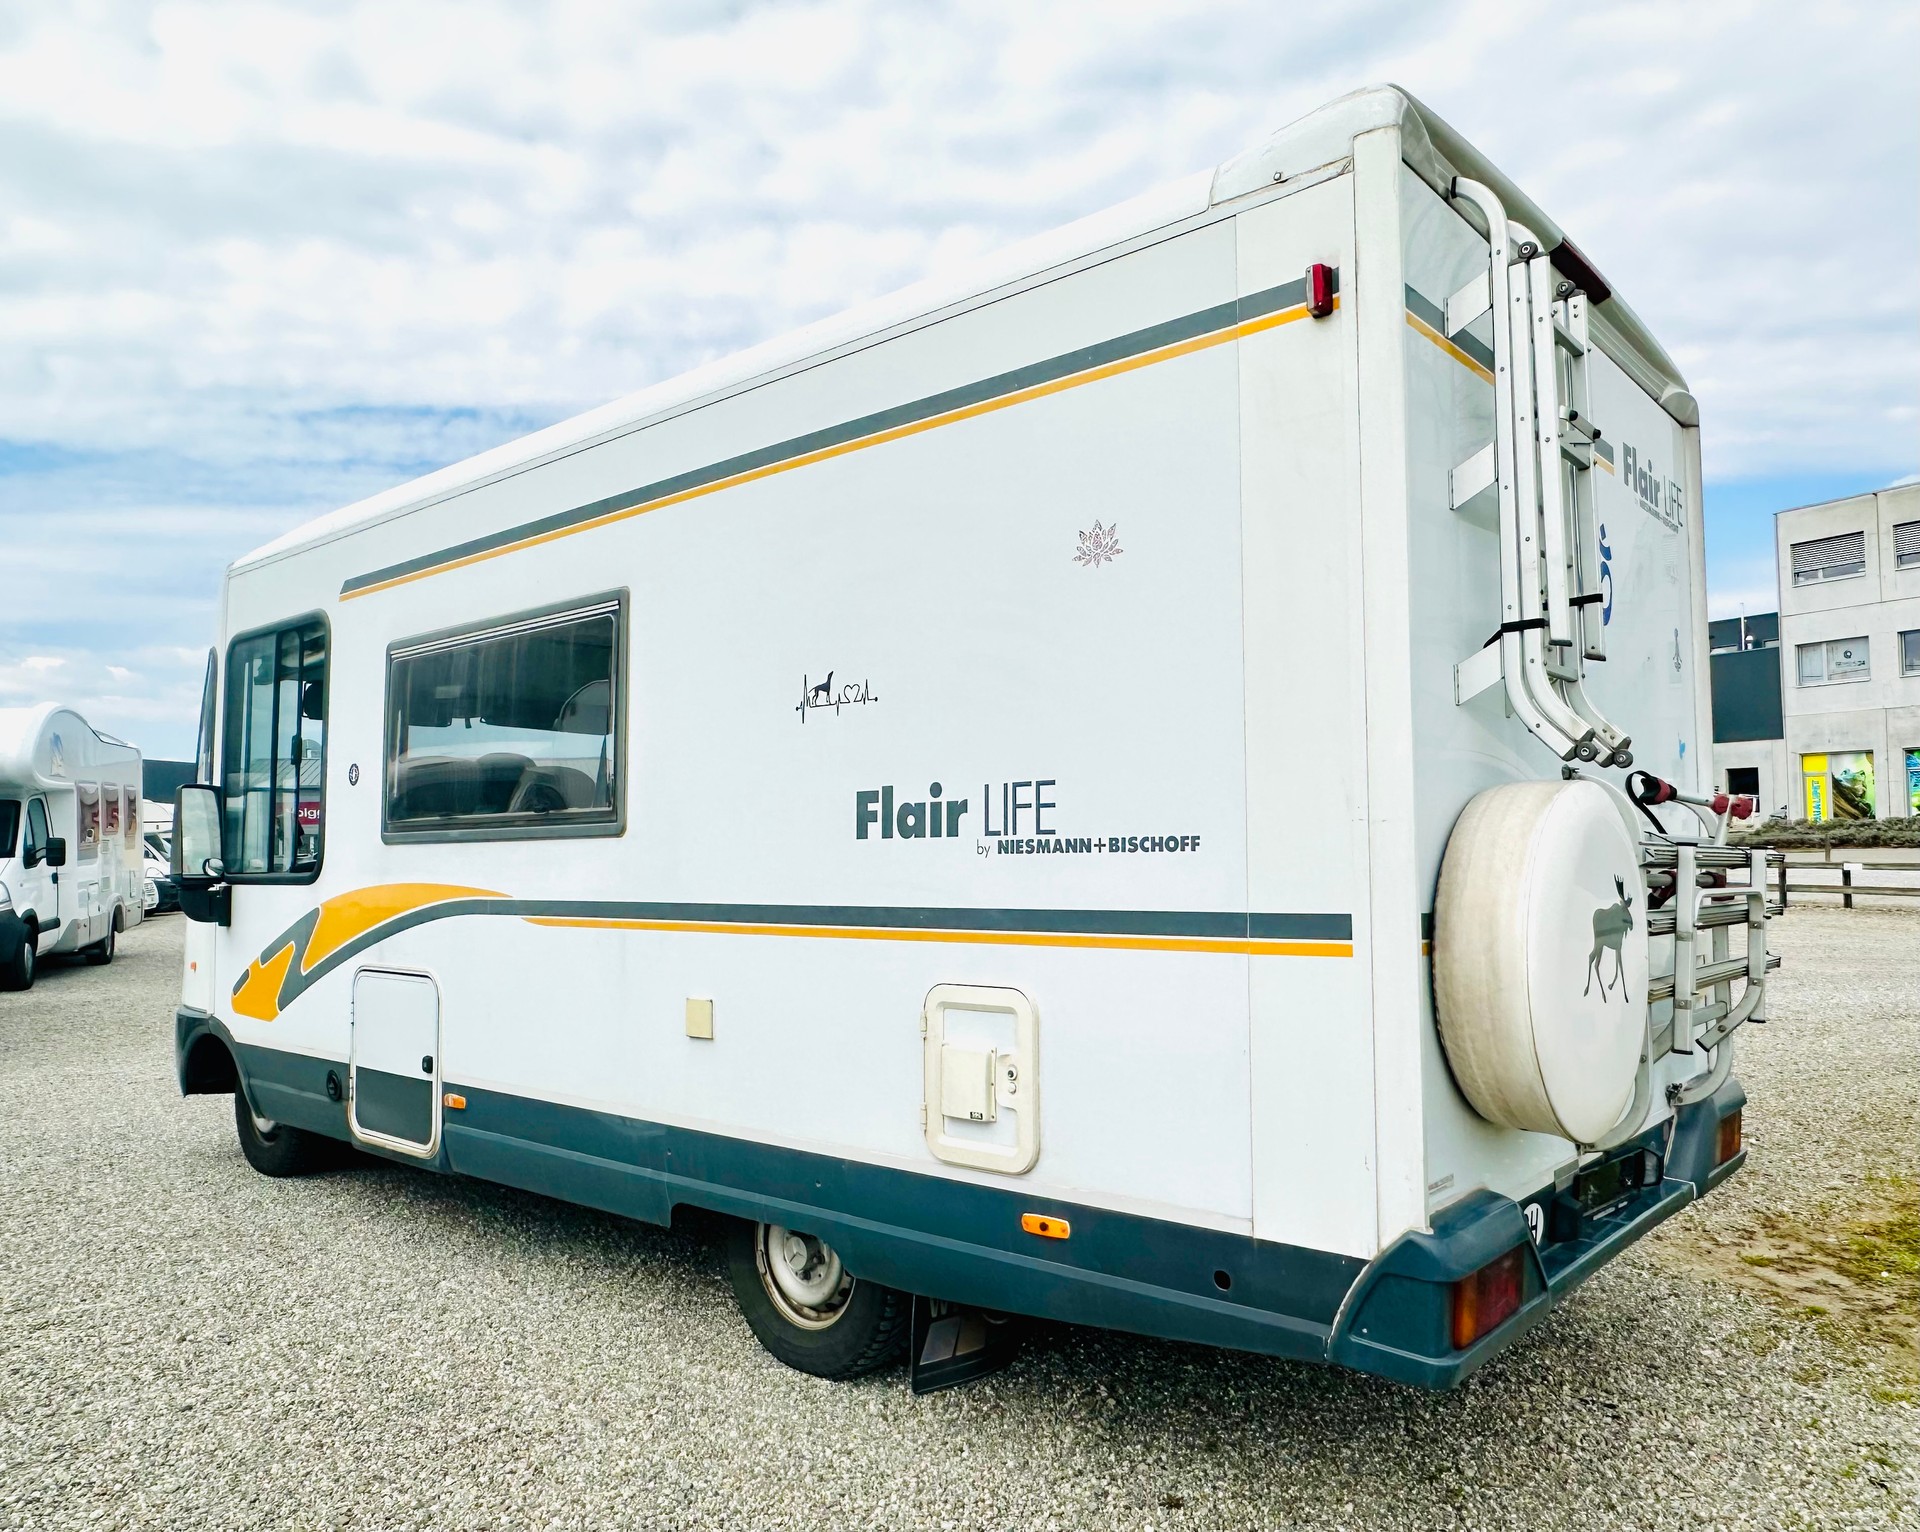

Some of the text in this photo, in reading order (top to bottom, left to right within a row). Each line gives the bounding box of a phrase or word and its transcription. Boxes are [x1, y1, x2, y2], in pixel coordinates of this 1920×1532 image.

[1623, 442, 1660, 508] Flair
[1664, 474, 1683, 528] LIFE
[856, 780, 1056, 840] Flair LIFE
[976, 835, 1201, 858] by NIESMANN+BISCHOFF
